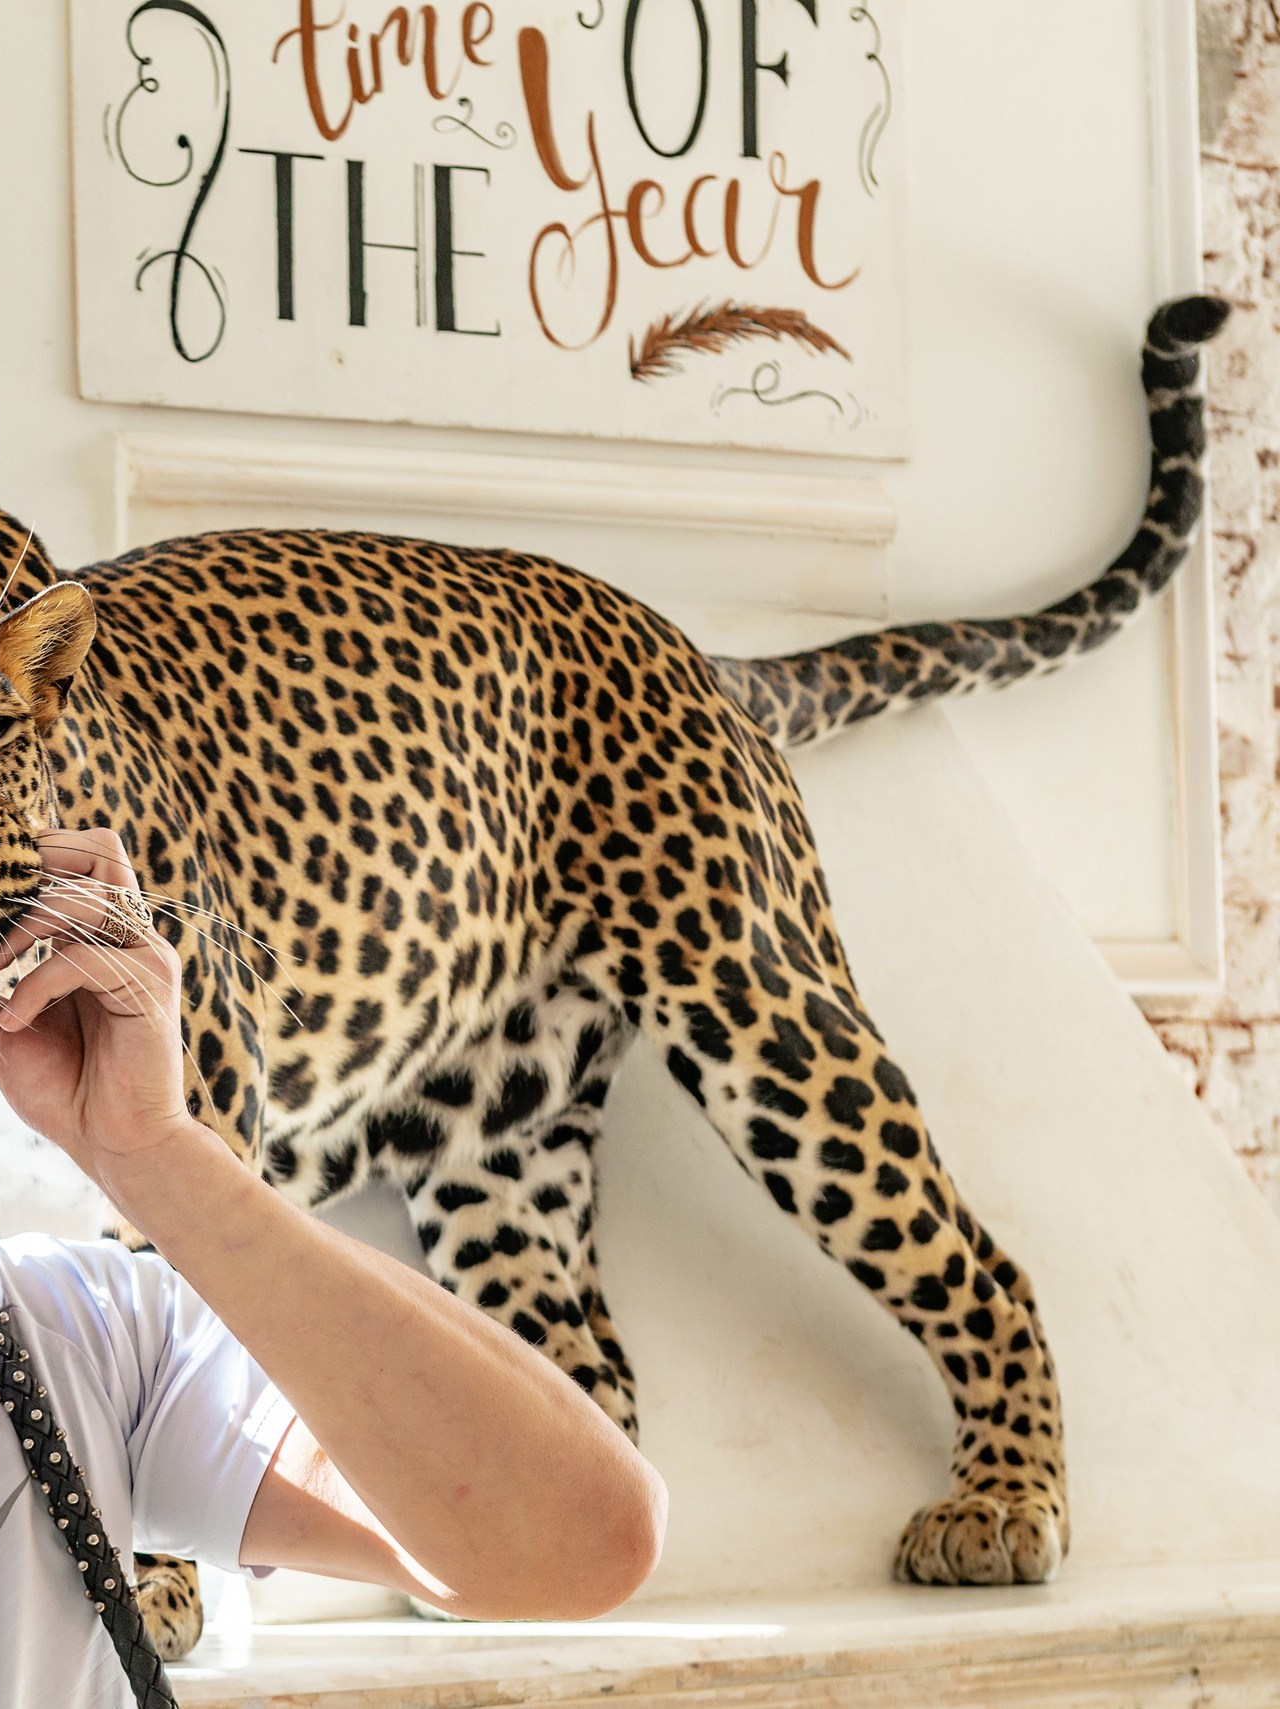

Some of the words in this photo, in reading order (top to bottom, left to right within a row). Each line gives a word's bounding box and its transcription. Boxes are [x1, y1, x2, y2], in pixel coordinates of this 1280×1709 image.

[272, 0, 495, 142] time
[623, 0, 818, 159] OF
[237, 148, 501, 337] THE
